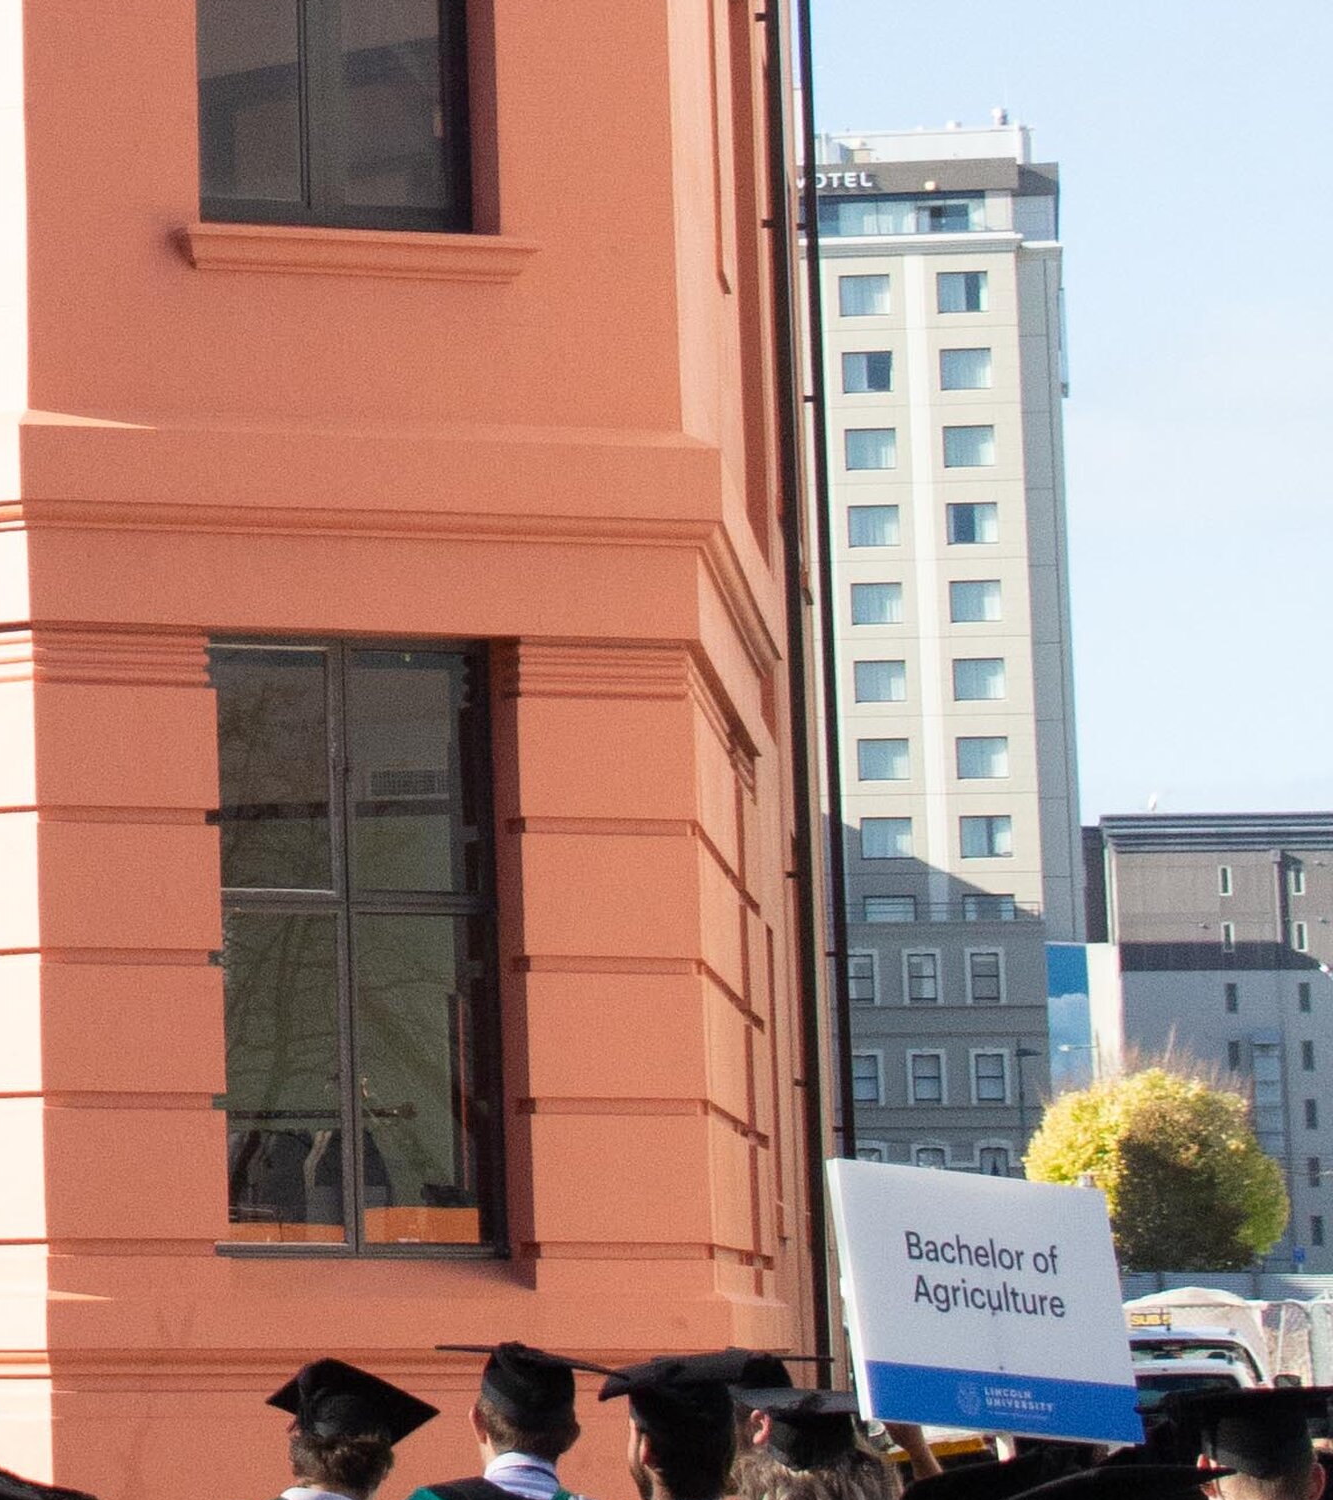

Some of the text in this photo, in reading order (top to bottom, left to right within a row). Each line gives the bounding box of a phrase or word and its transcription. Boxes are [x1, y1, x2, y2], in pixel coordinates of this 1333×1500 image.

[904, 1230, 1059, 1276] Bachelor of
[913, 1274, 1066, 1319] Agriculture
[984, 1386, 1032, 1399] LINCOLN
[985, 1396, 1054, 1413] UNIVERSITY
